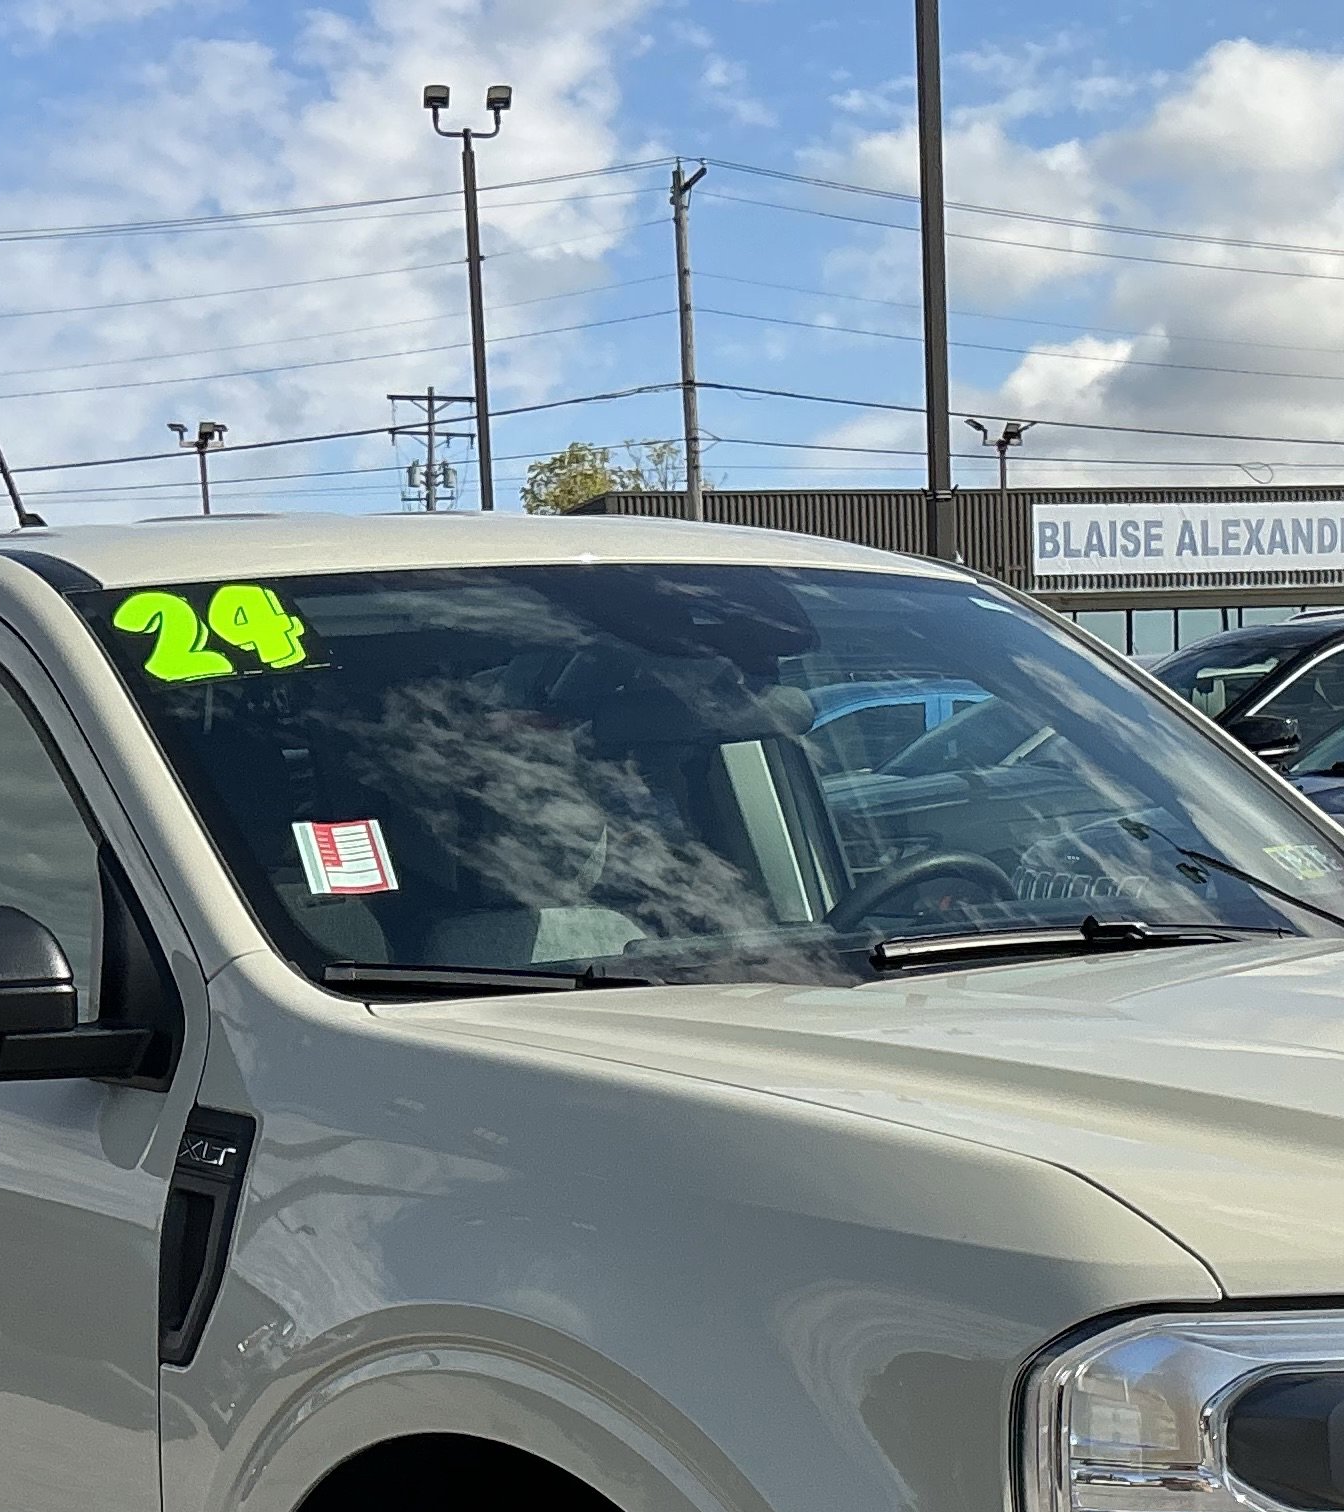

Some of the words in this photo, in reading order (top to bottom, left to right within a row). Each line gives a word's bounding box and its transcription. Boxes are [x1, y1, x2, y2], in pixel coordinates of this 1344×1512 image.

[1038, 520, 1164, 559] BLAISE
[113, 584, 306, 682] 24
[178, 1138, 237, 1166] XLT
